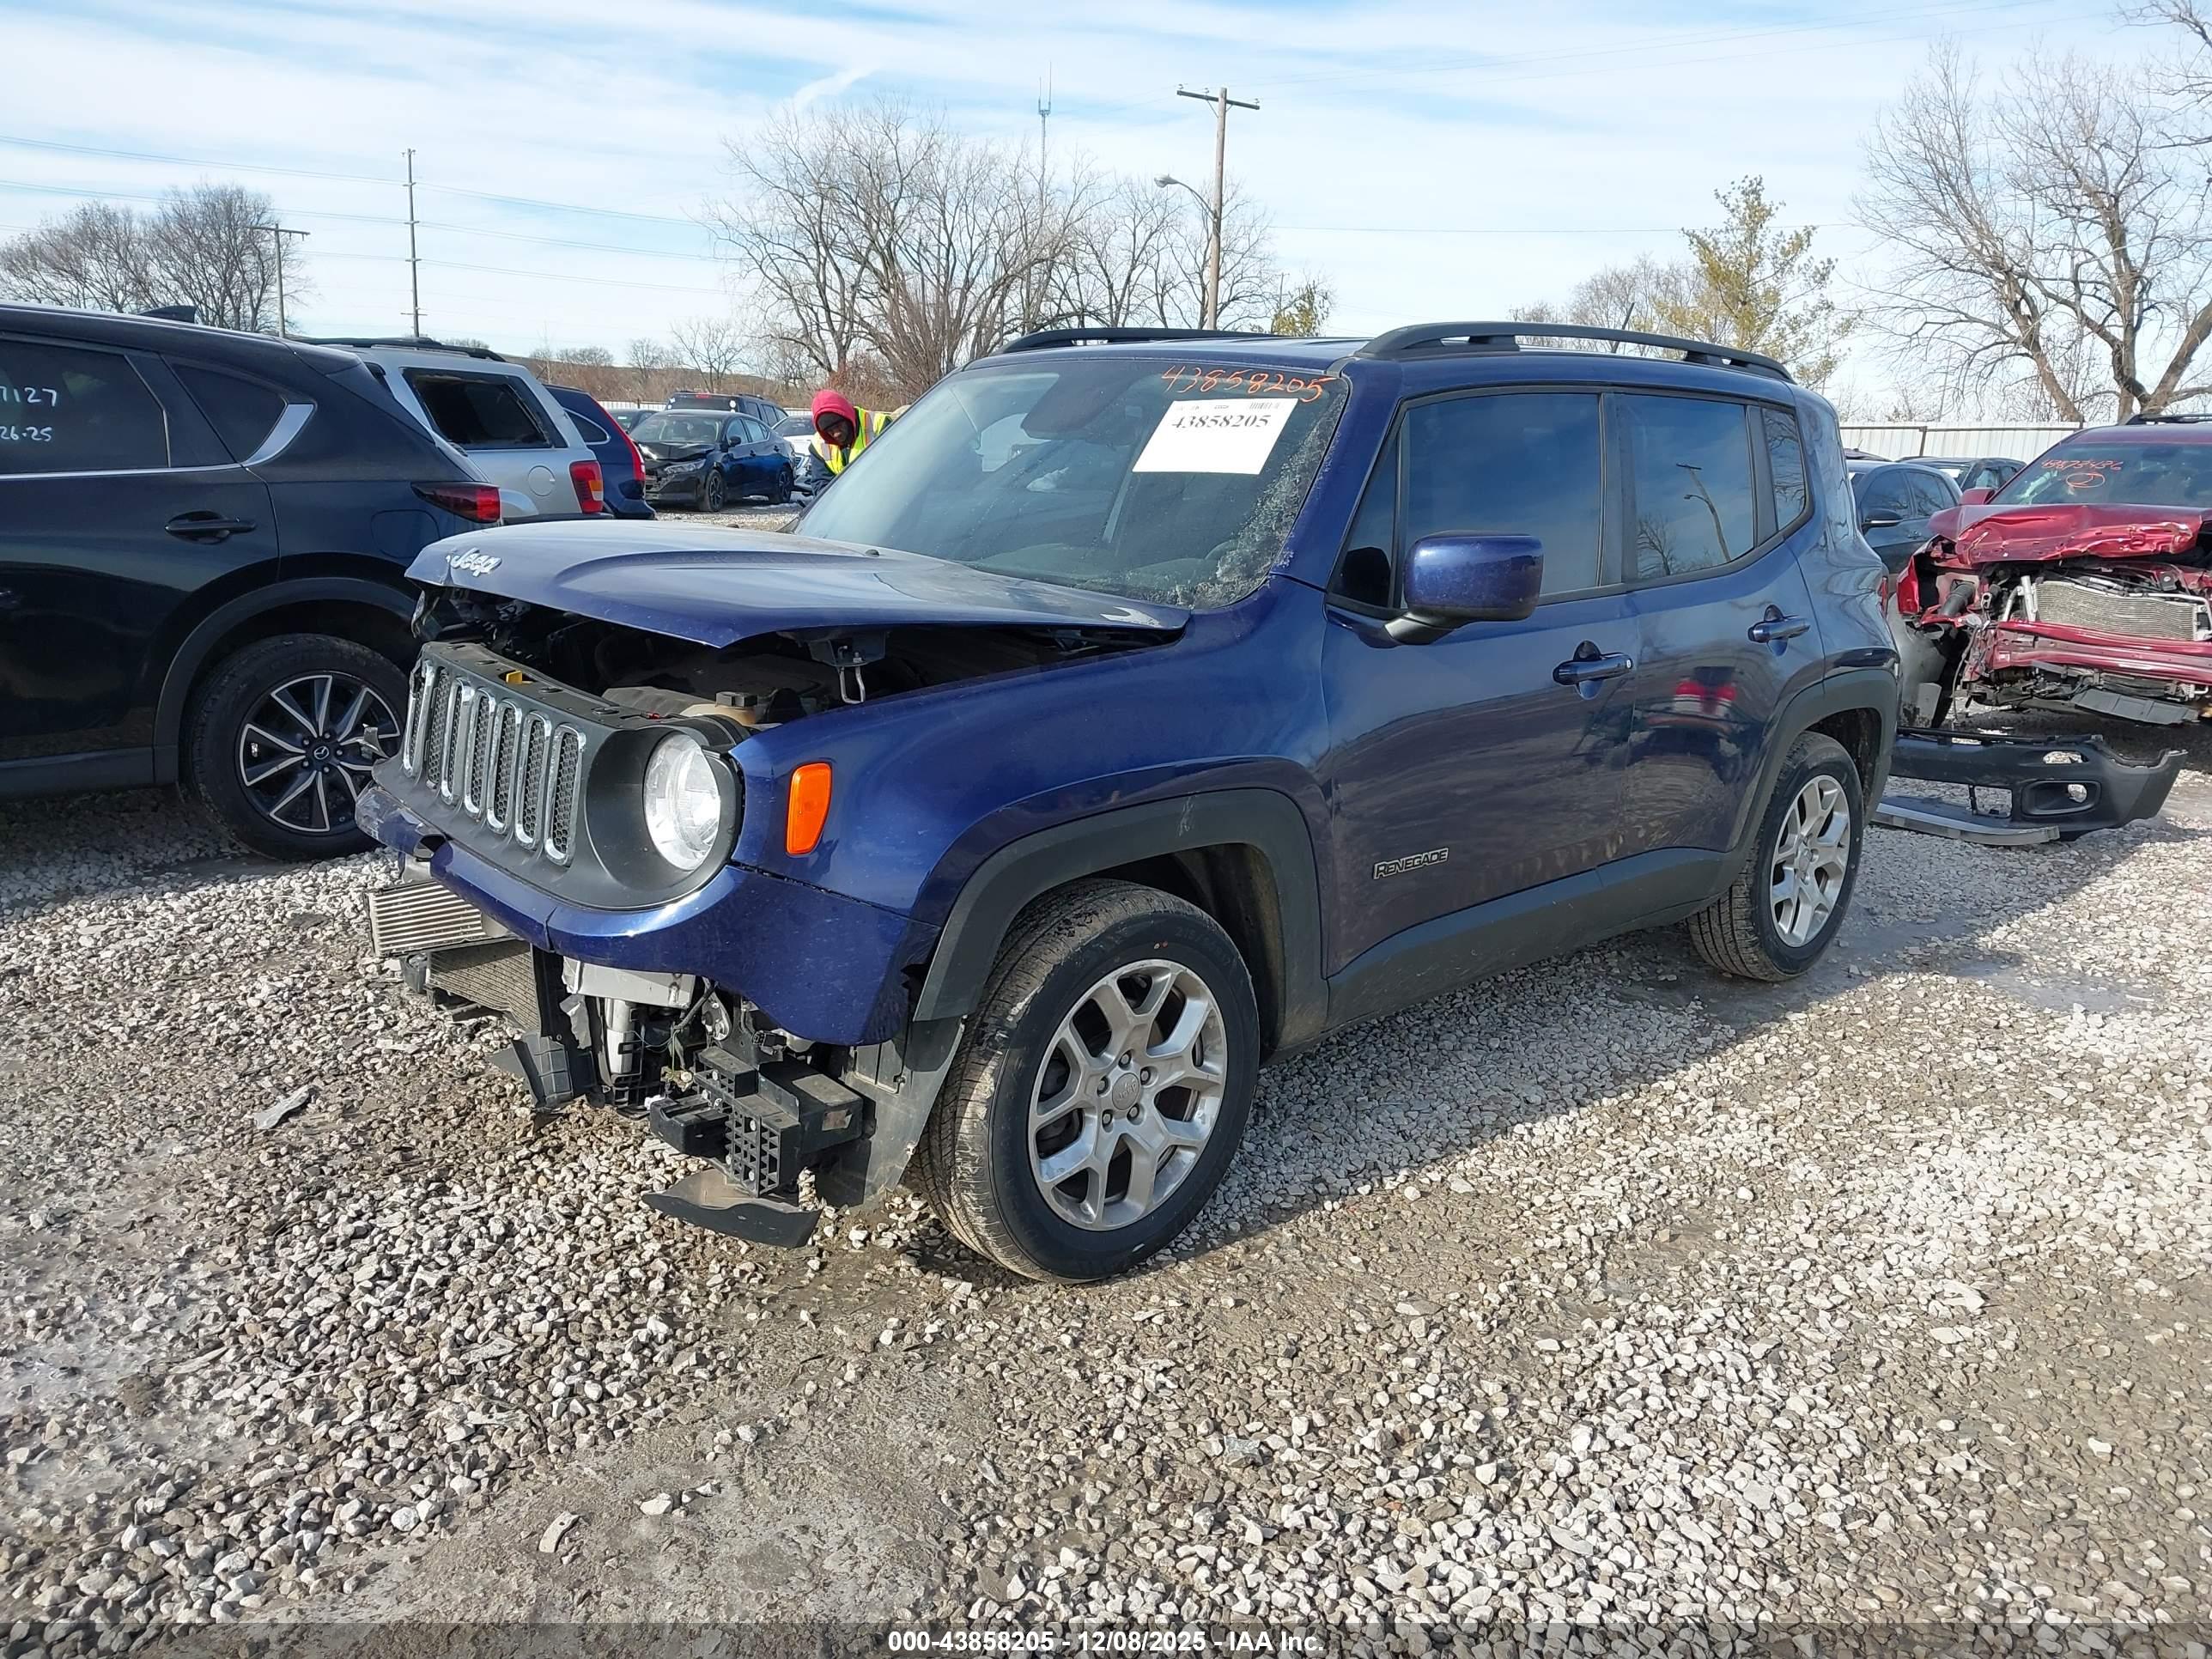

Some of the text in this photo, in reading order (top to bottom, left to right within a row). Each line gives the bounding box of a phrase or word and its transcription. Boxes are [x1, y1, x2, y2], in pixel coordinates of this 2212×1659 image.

[1161, 365, 1337, 403] 43858205
[1171, 414, 1272, 428] 43858205
[450, 547, 501, 577] Jeep
[1373, 848, 1449, 880] RENEGADE
